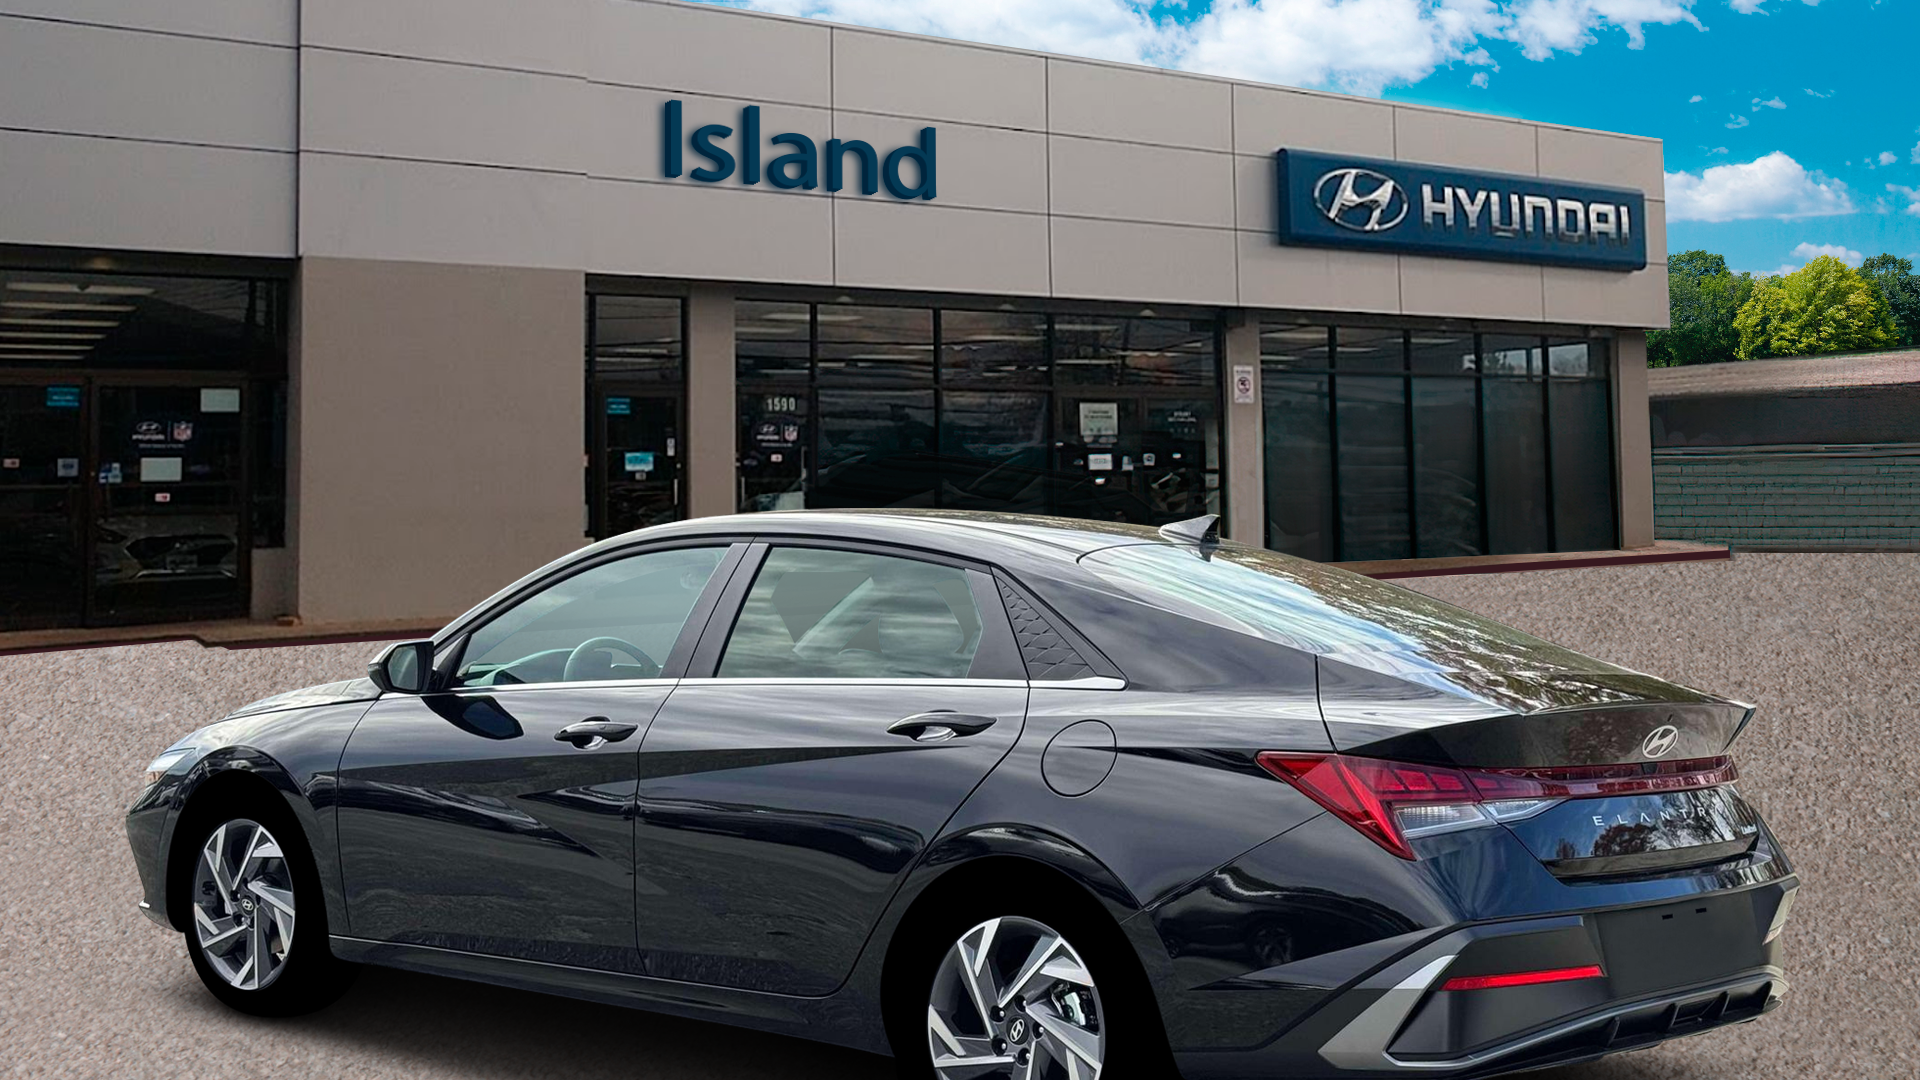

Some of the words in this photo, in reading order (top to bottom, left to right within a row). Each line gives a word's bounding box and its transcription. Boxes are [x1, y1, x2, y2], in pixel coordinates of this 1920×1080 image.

[663, 98, 937, 201] Island
[1420, 183, 1631, 247] HYUNDAI
[766, 396, 797, 412] 1590
